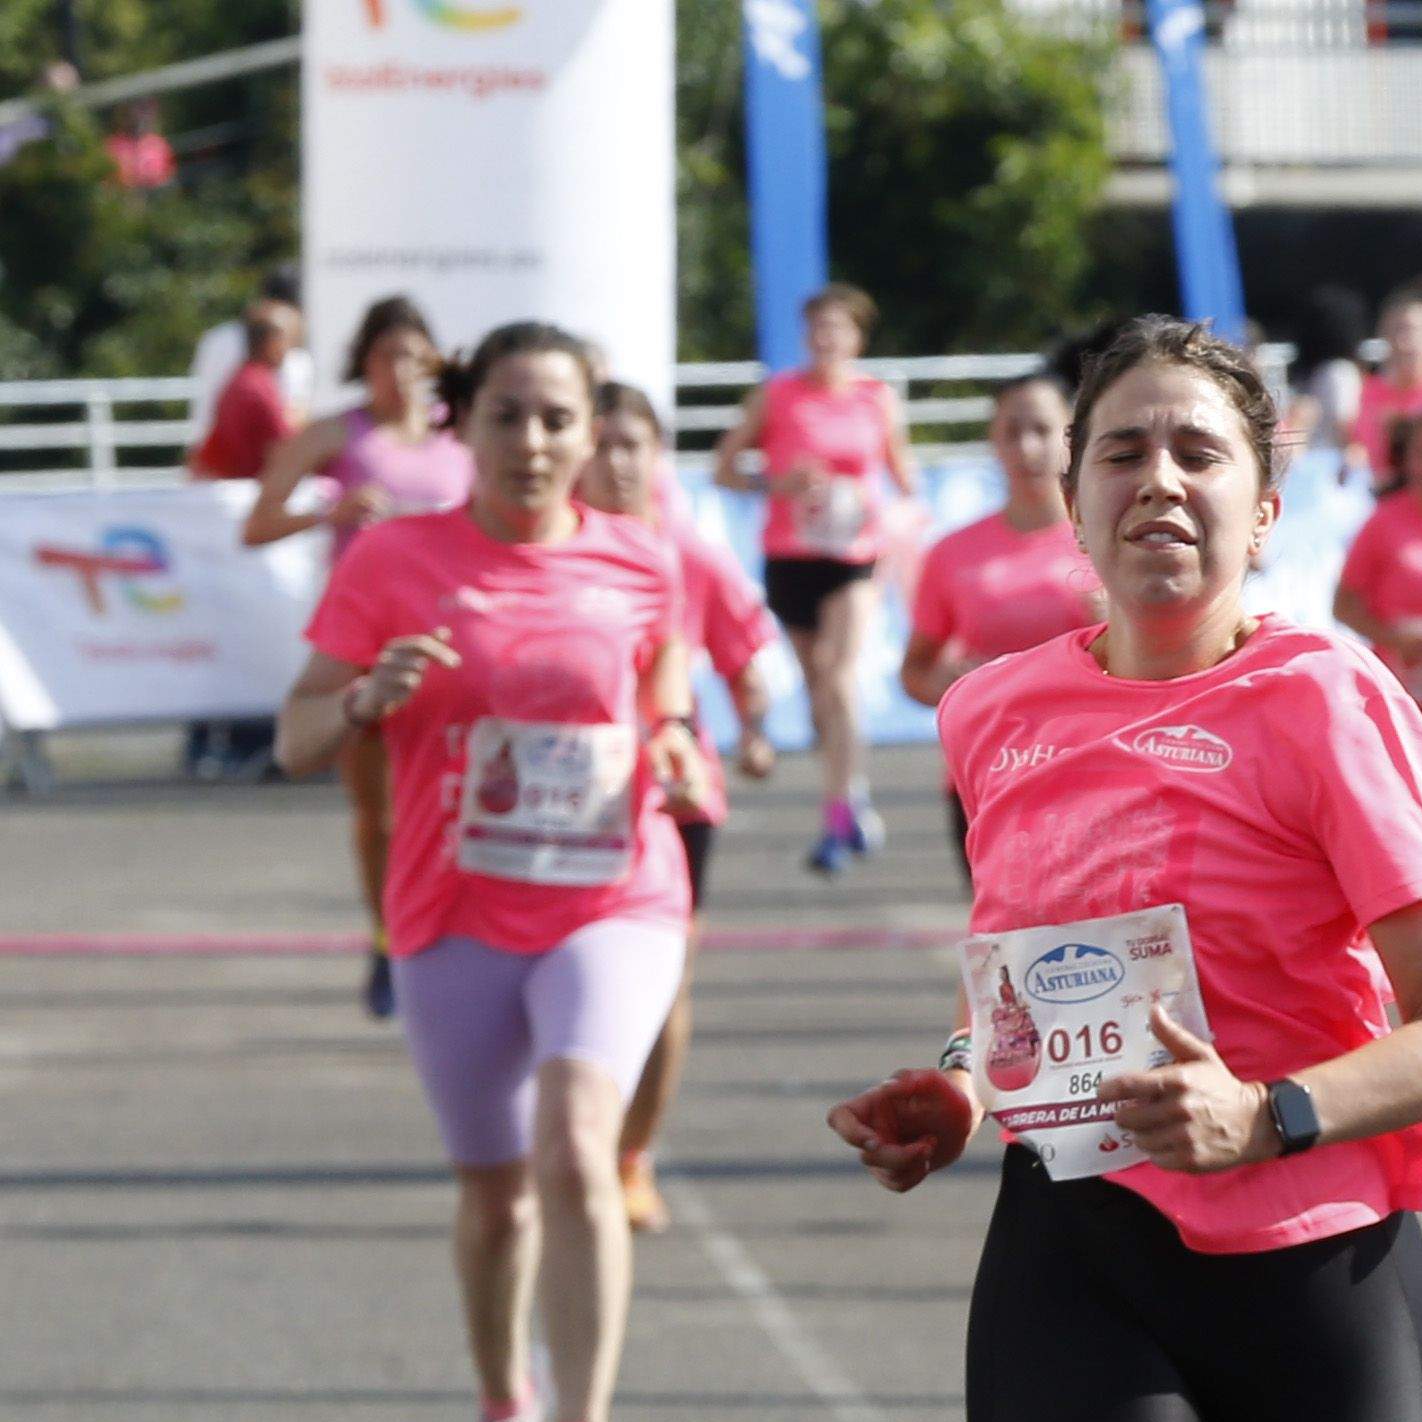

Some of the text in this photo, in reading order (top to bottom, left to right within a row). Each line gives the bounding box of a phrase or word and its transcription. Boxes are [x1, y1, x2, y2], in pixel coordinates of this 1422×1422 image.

[1144, 737, 1224, 766] ASTURIANA
[1129, 943, 1172, 961] SUMA
[1034, 966, 1117, 993] ASTURIANA
[1048, 1020, 1123, 1063] 016
